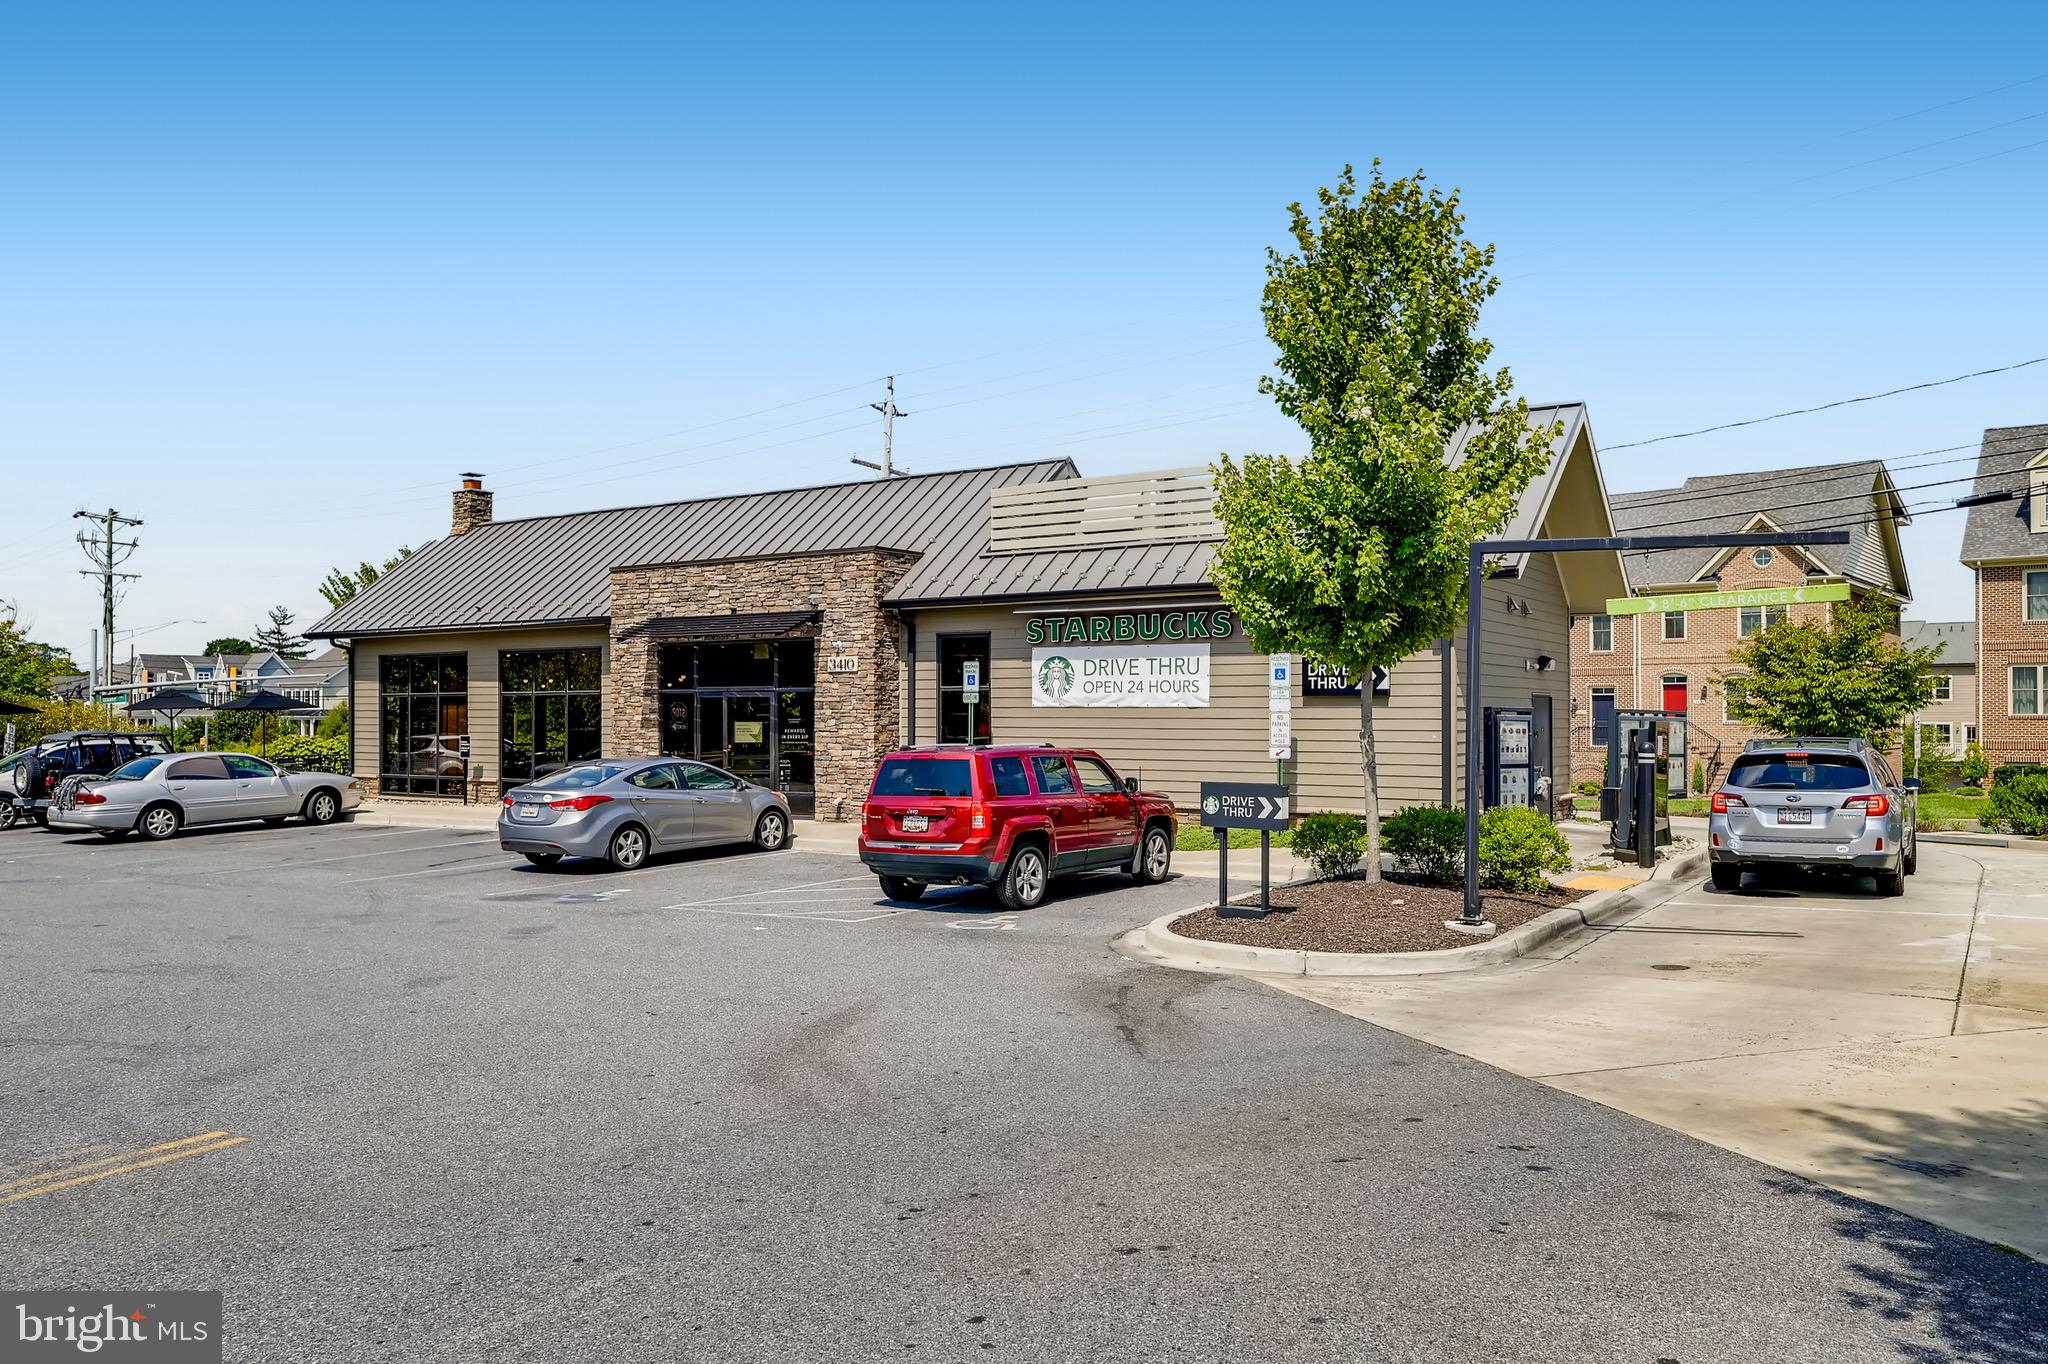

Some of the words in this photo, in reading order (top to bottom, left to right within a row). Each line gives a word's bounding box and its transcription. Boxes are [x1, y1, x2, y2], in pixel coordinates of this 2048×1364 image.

[1700, 592, 1787, 607] CLEARANCE
[1025, 610, 1232, 644] STARBUCKS
[828, 658, 855, 671] 3410
[1083, 659, 1139, 676] DRIVE
[1146, 657, 1200, 676] THRU
[1307, 664, 1349, 676] DRVE
[1083, 680, 1123, 694] OPEN
[1128, 680, 1143, 693] 24
[1149, 680, 1200, 693] HOURS
[1307, 677, 1347, 690] THRU
[1222, 796, 1255, 807] DRIVE
[1222, 806, 1253, 818] THRU
